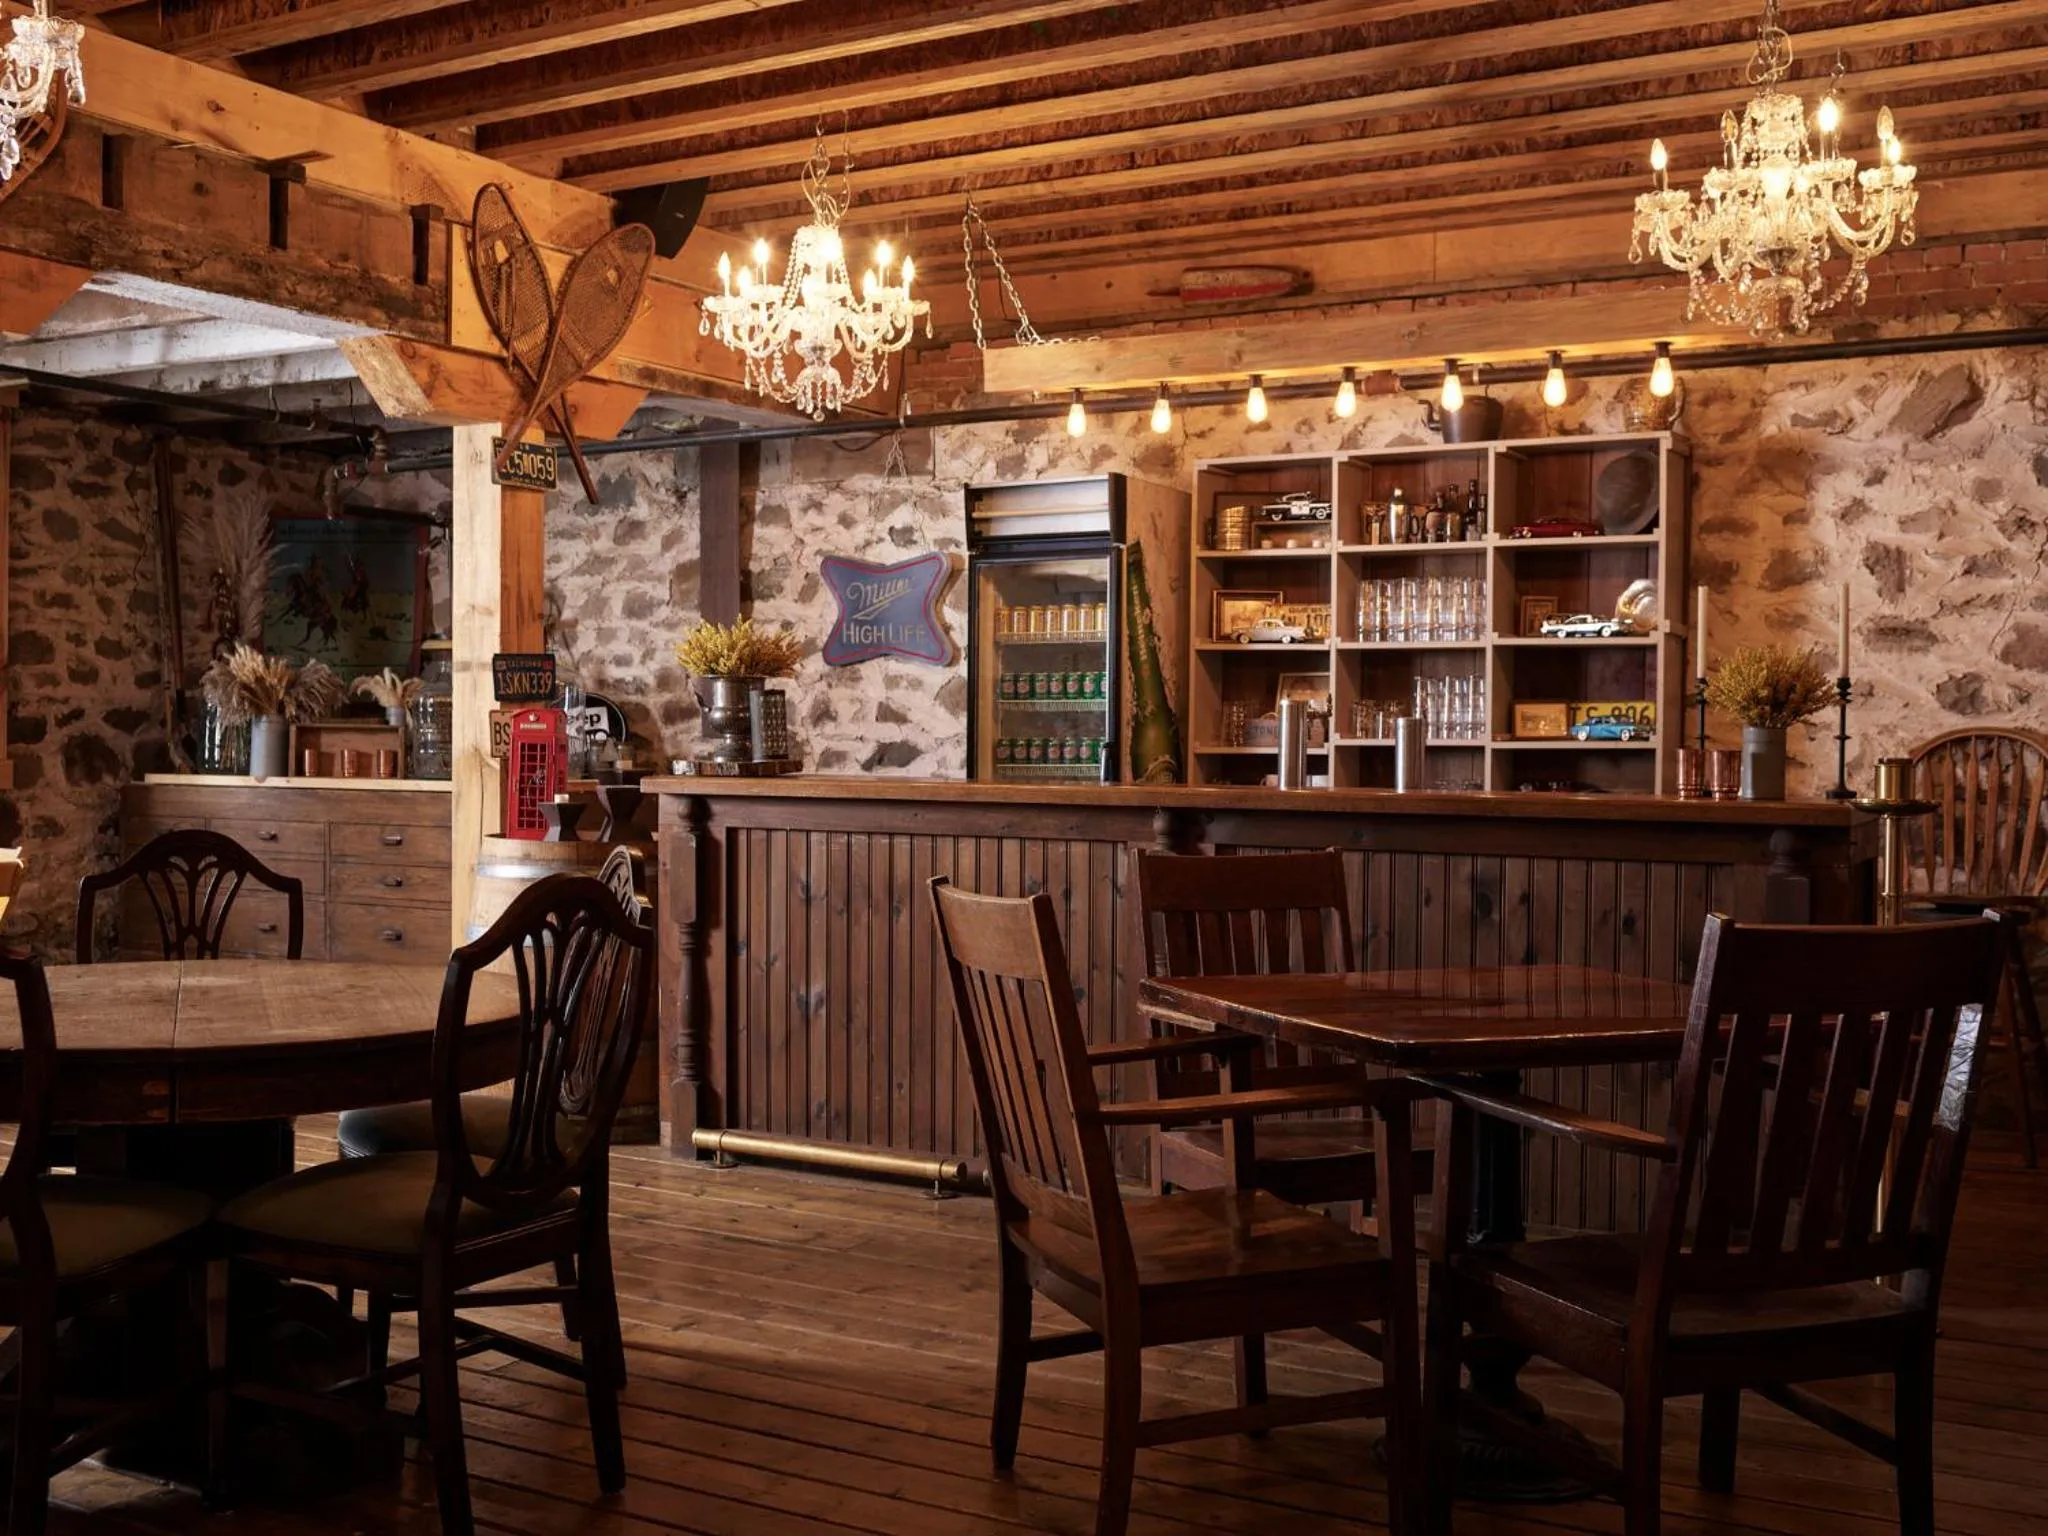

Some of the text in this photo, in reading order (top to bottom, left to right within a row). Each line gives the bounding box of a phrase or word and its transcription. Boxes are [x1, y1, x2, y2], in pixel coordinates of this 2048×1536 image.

[846, 577, 912, 611] Miller
[843, 622, 885, 644] HIGH
[498, 671, 553, 695] 1SKN339
